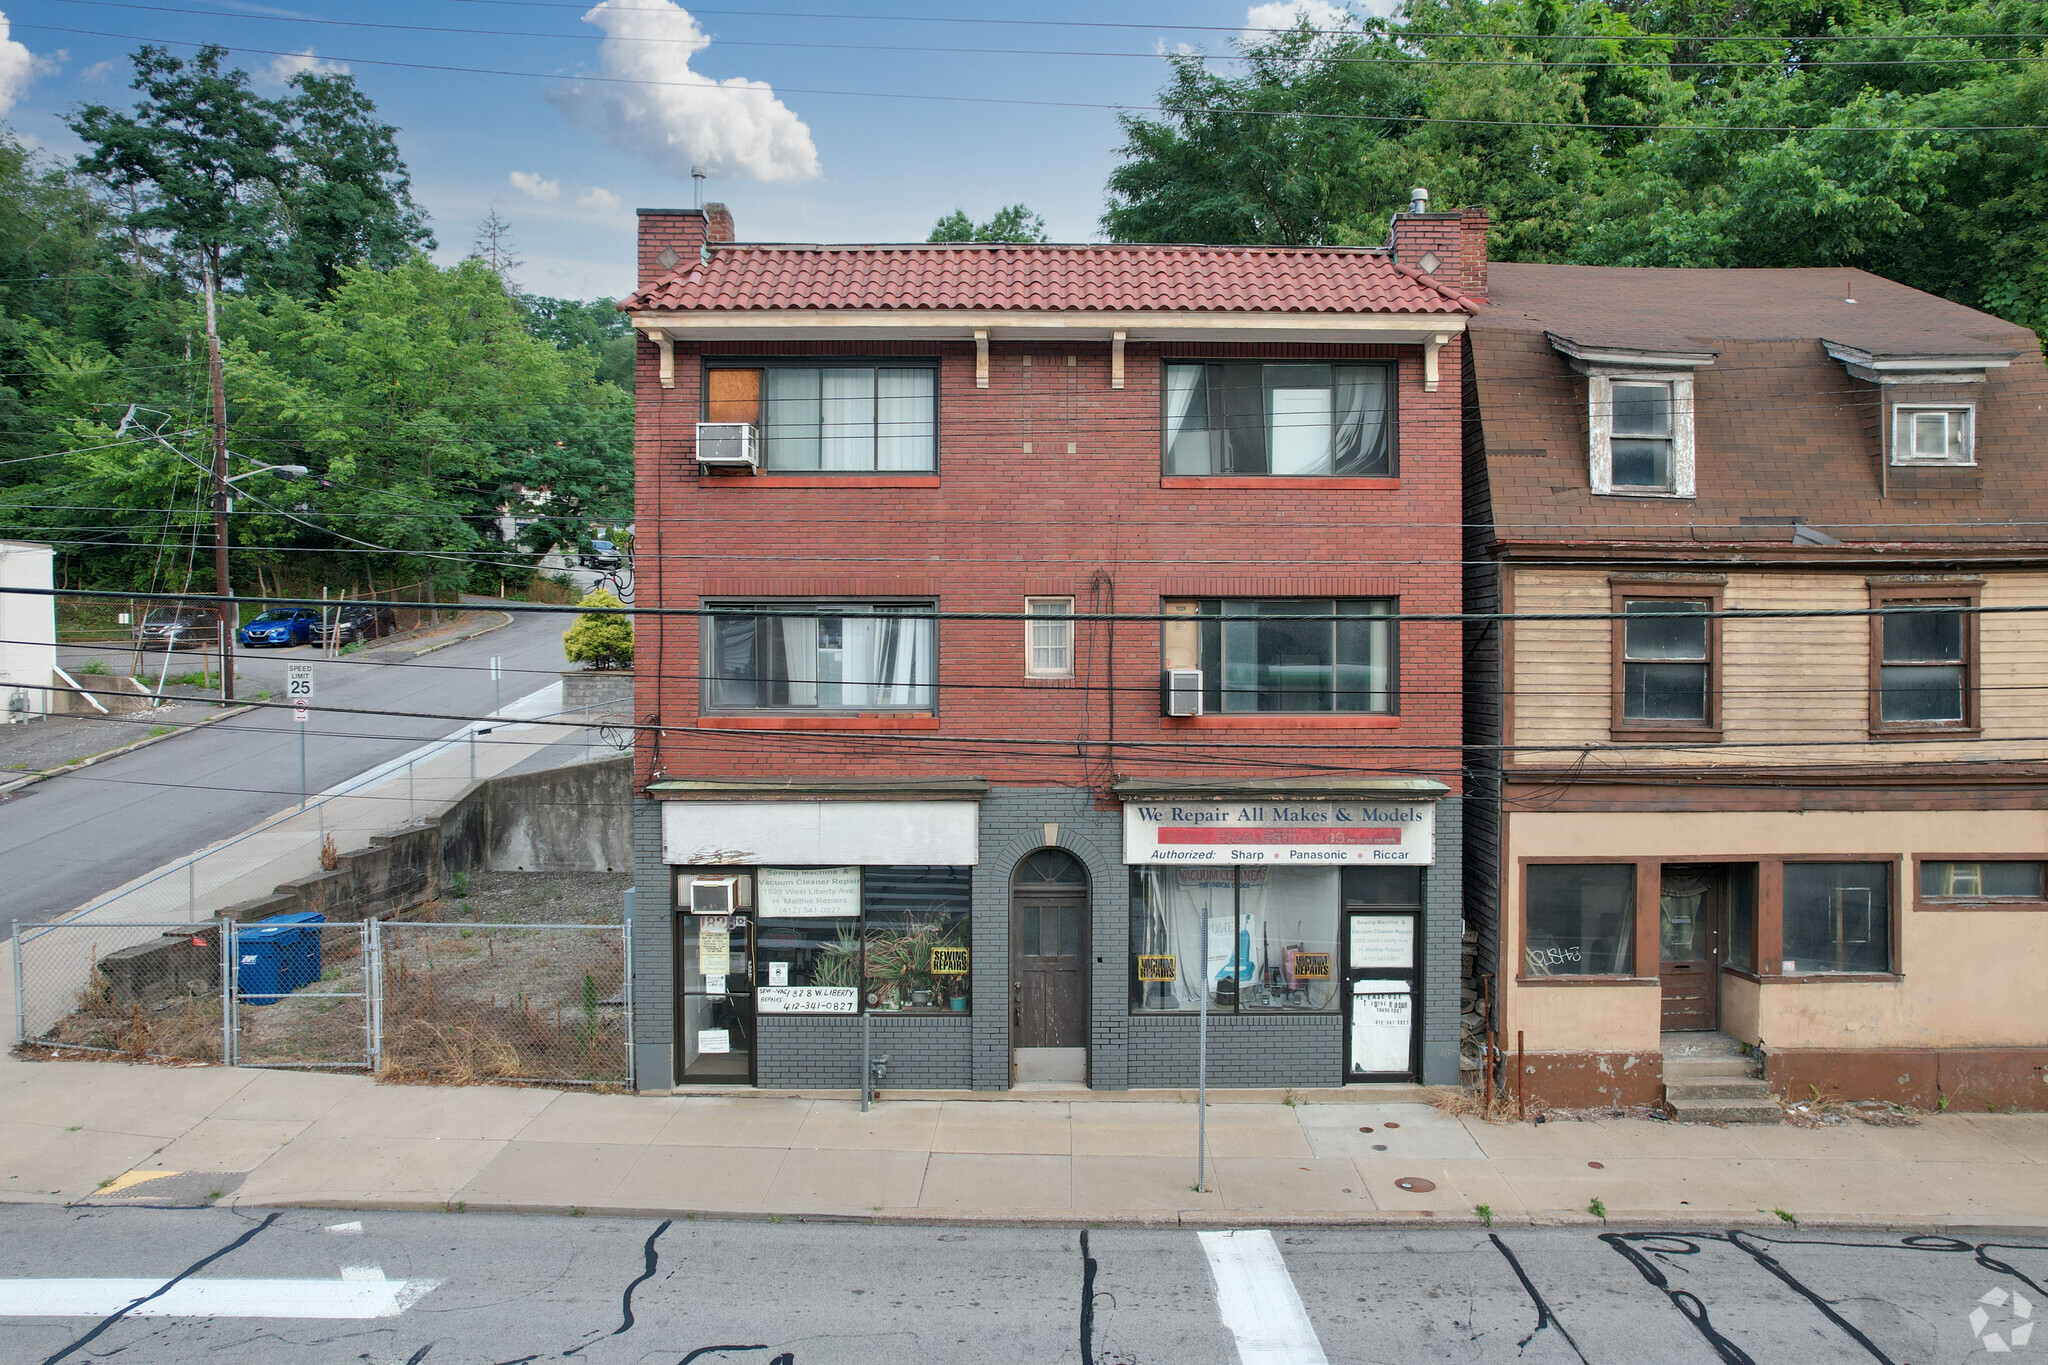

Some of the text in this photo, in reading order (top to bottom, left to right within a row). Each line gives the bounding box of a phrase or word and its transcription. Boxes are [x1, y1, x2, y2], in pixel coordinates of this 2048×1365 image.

[291, 681, 310, 694] 25
[1138, 807, 1423, 824] We Repair All Makes & Models
[1151, 850, 1409, 861] Authorized: Sharp Panasonic Riccar
[1180, 870, 1218, 881] VACUUM
[816, 897, 848, 905] Repairs
[934, 951, 967, 961] SEWING
[1295, 955, 1328, 966] VACUUM
[933, 960, 968, 971] REPAIRS
[1141, 958, 1174, 969] VACUUM
[1140, 967, 1175, 978] REPAIRS
[1295, 965, 1329, 976] REPAIRS
[824, 989, 854, 997] LIBERTY
[783, 1002, 853, 1011] 412-341-0827
